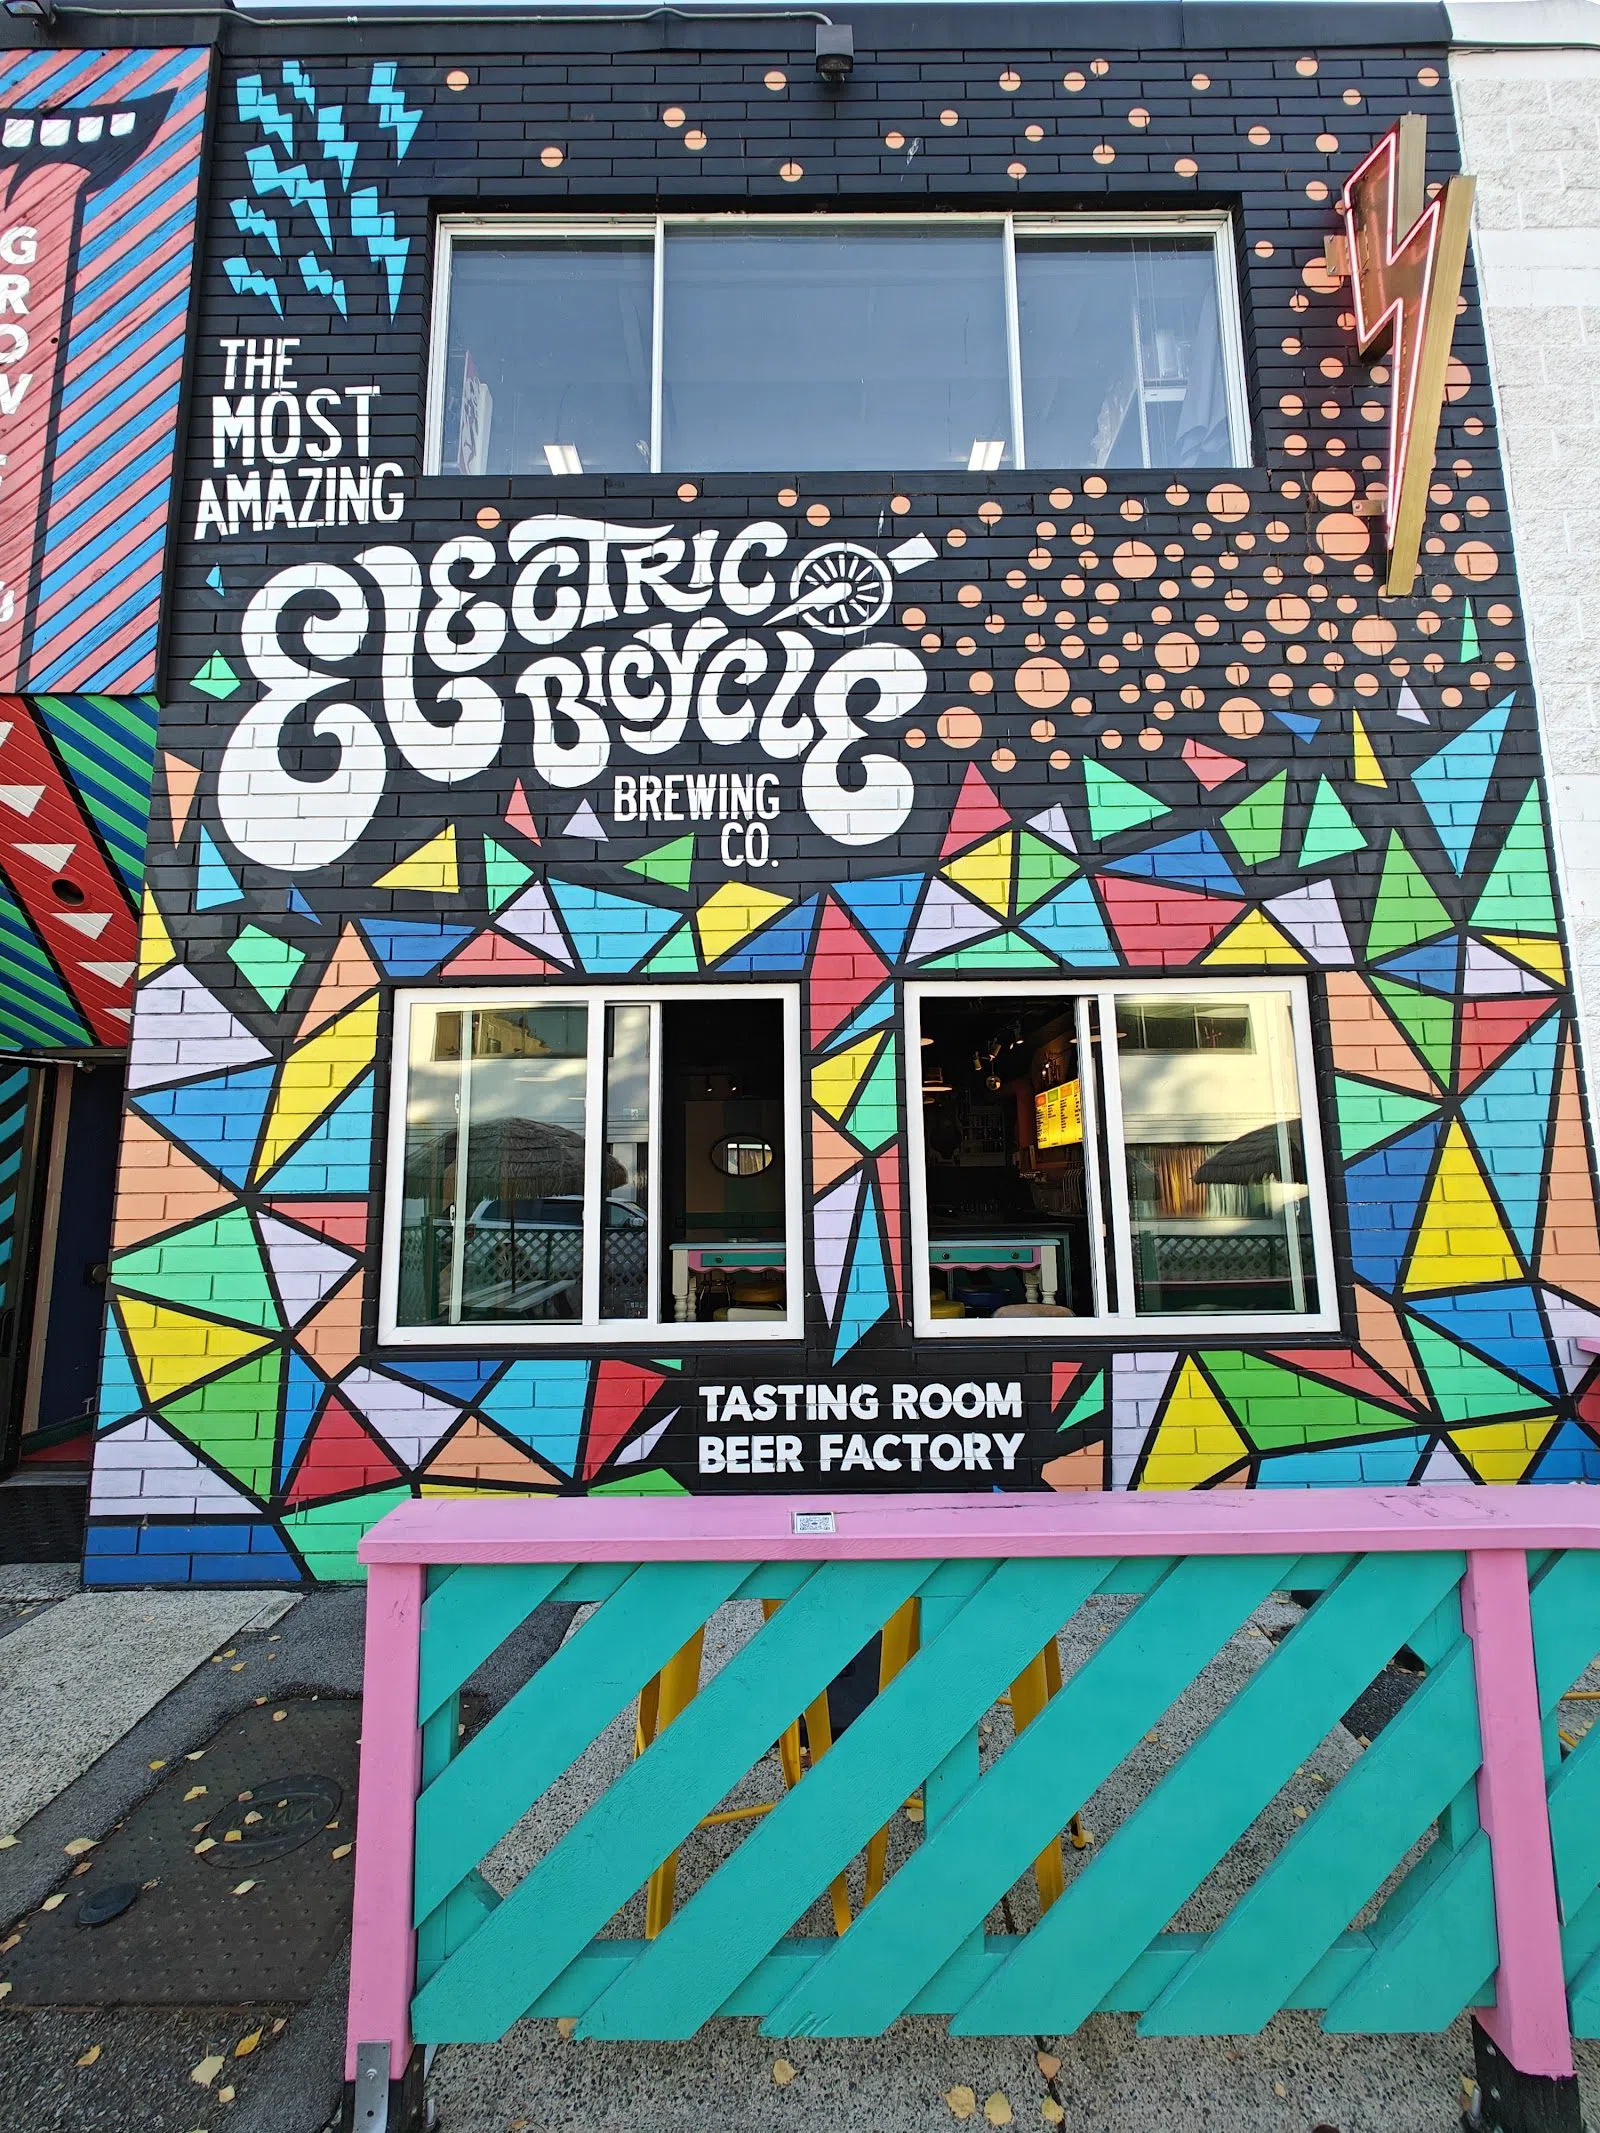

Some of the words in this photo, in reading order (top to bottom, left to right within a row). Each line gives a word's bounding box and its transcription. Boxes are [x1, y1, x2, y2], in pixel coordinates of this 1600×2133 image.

[220, 338, 300, 390] THE
[212, 385, 381, 469] MOST
[194, 462, 405, 540] AMAZING
[217, 514, 788, 872] ELECTRIC
[514, 616, 928, 847] BICYCLE
[613, 773, 781, 822] BREWING
[720, 821, 779, 868] CO.
[698, 1383, 879, 1422] TASTING
[892, 1382, 1023, 1420] ROOM
[698, 1436, 804, 1474] BEER
[819, 1432, 1026, 1472] FACTORY
